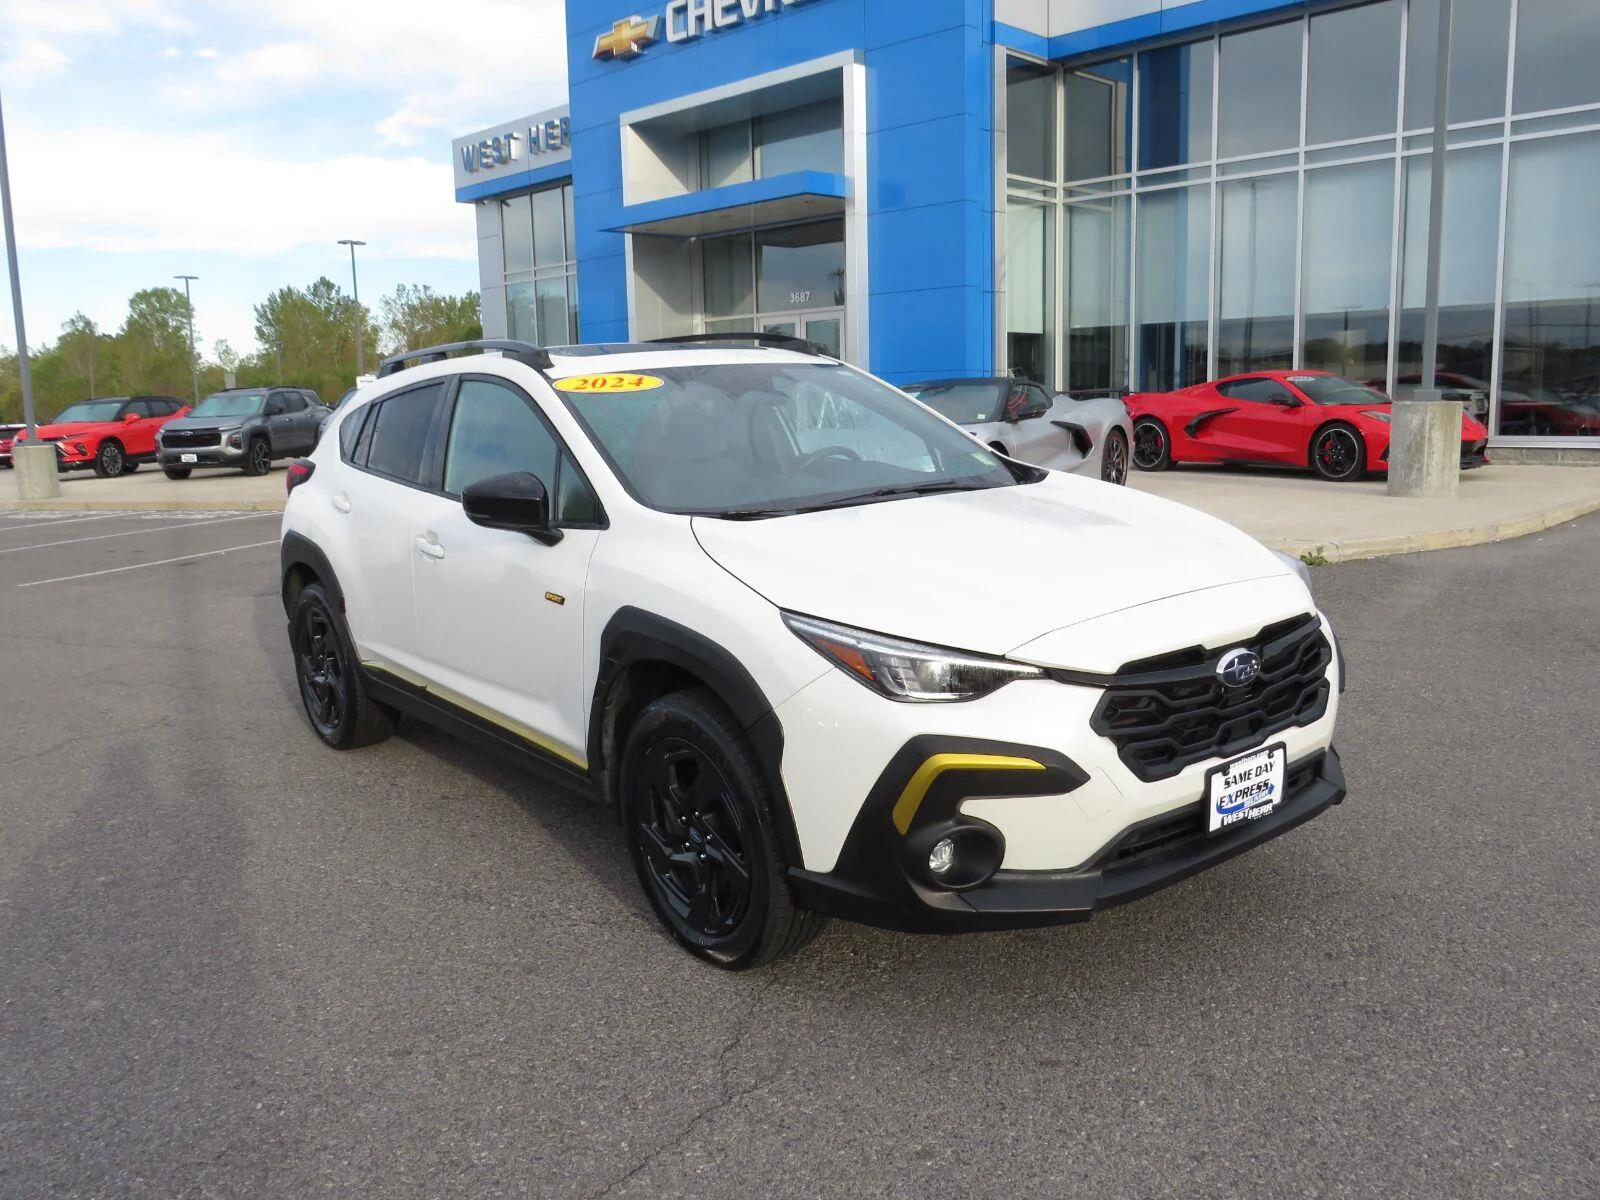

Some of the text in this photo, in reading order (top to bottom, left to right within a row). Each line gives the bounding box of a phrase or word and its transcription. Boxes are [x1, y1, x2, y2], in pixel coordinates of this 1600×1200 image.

[666, 0, 798, 43] CHE
[461, 132, 520, 173] WEST
[790, 290, 810, 303] 3687
[574, 376, 644, 390] 2024
[1224, 760, 1276, 789] SAME DAY
[1220, 779, 1270, 808] EXPRESS
